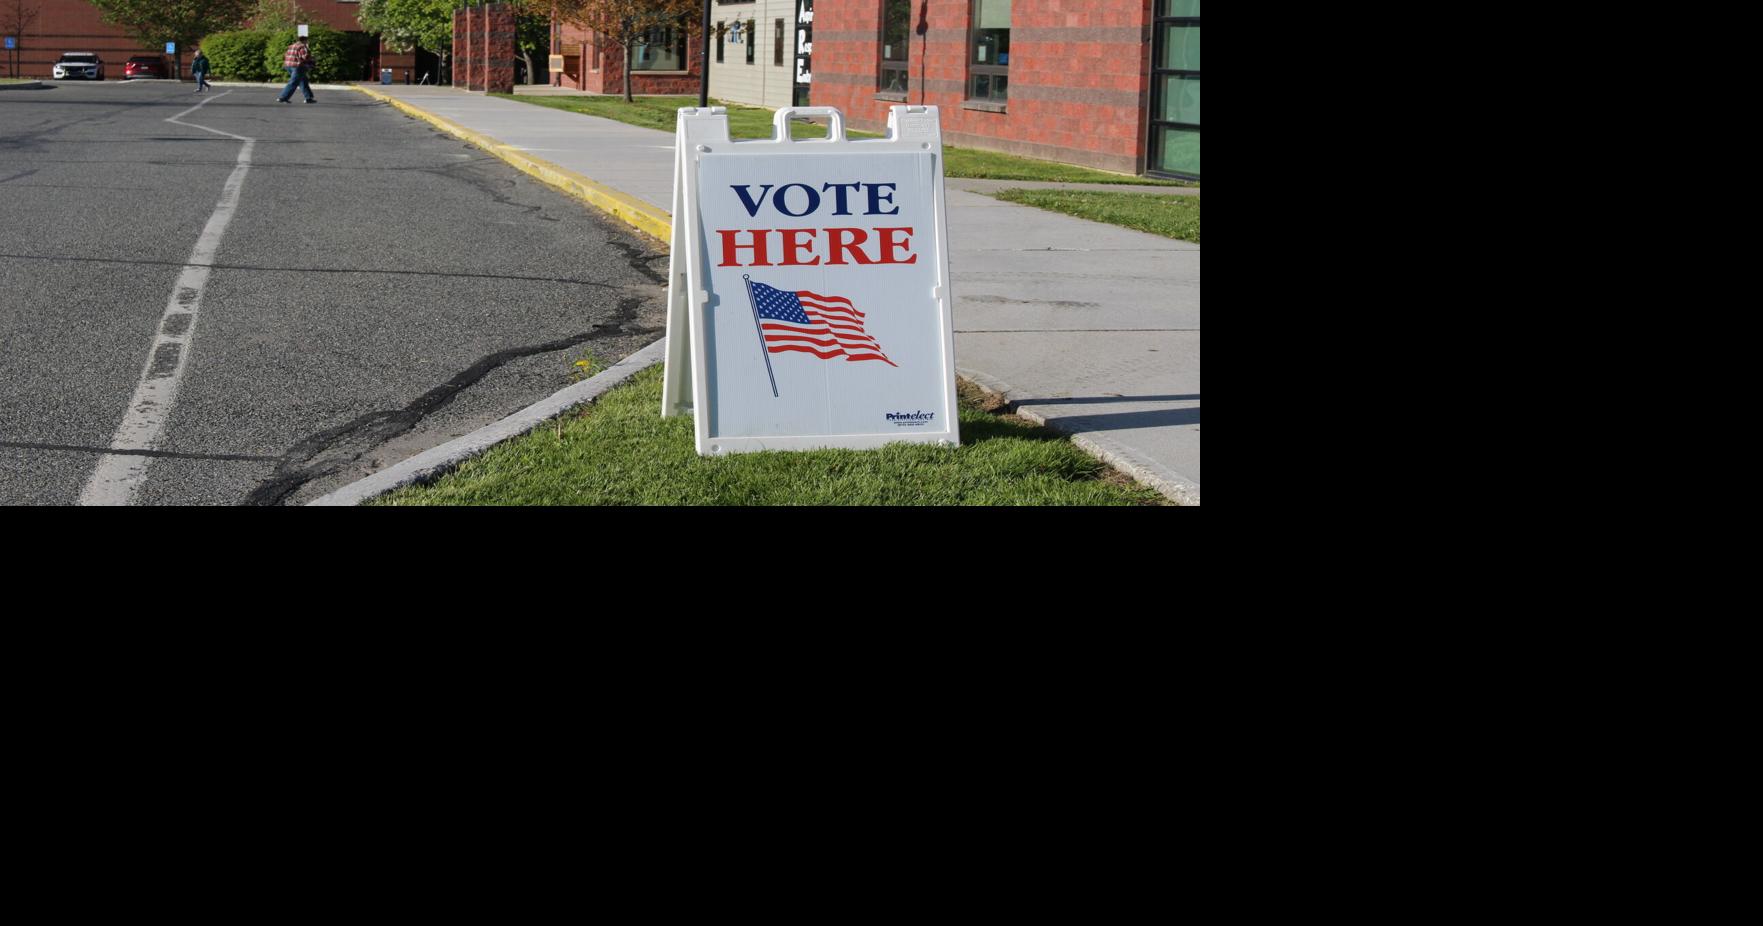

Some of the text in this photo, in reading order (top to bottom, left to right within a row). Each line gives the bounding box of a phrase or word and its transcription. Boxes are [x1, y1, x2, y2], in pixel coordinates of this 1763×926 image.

[730, 181, 900, 217] VOTE
[716, 226, 918, 267] HERE
[886, 410, 934, 420] Printelect
